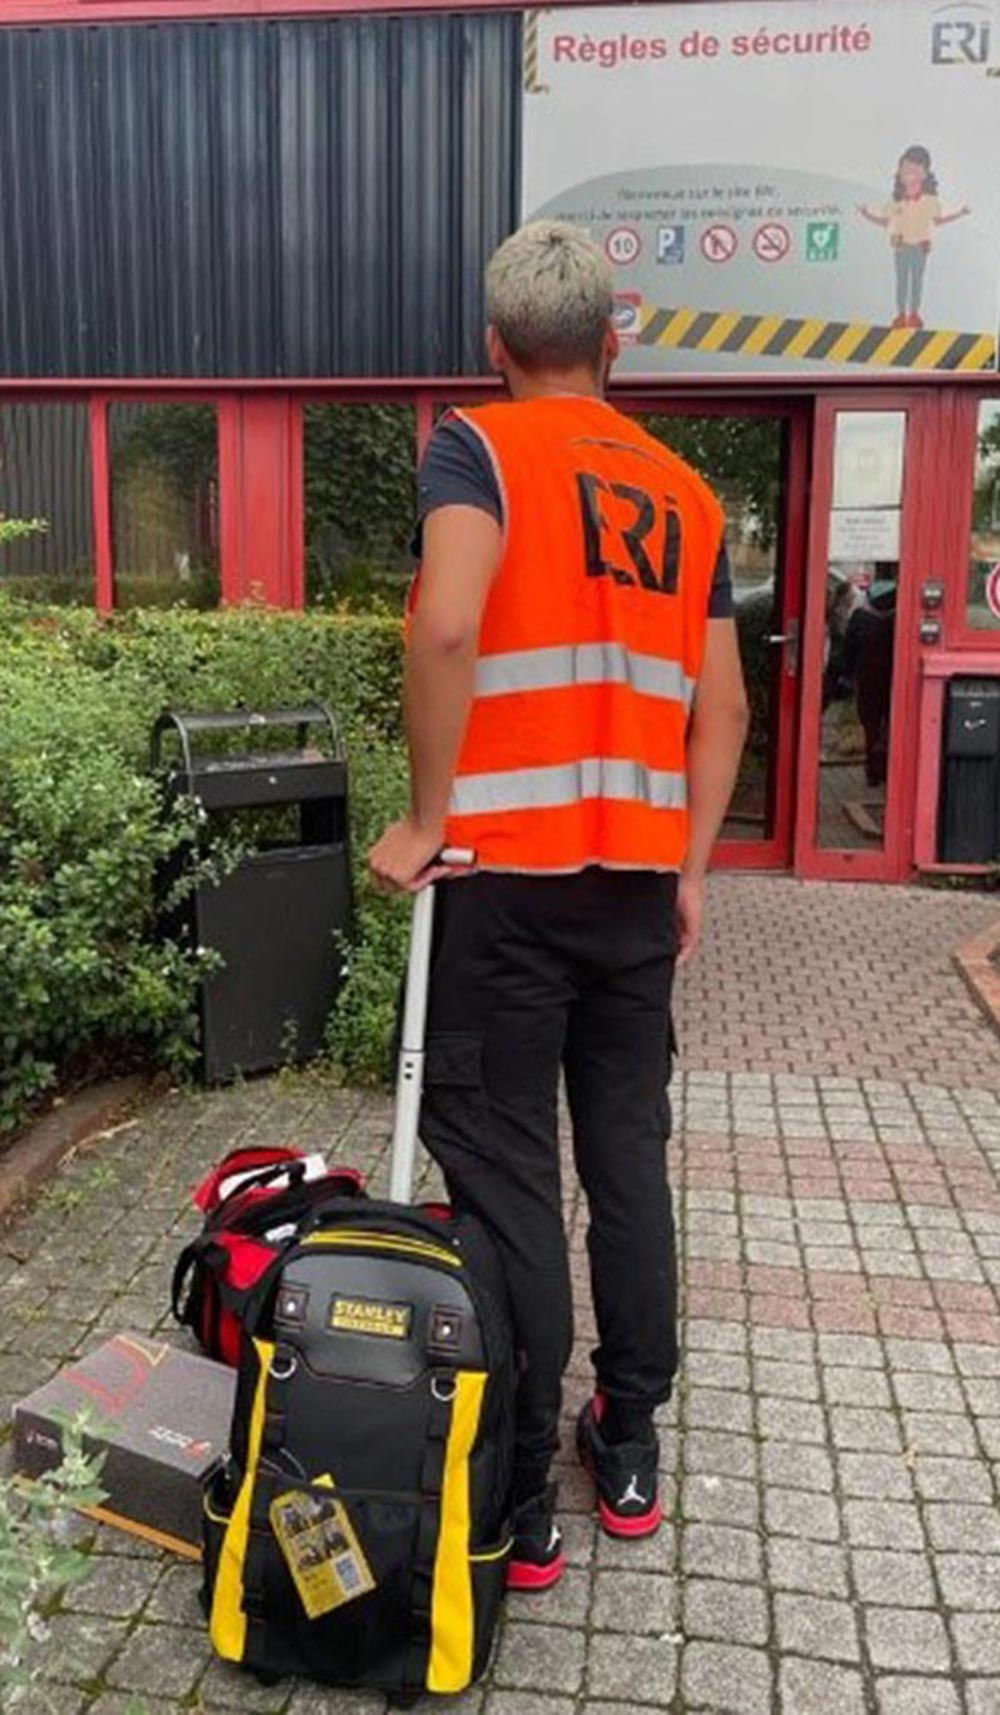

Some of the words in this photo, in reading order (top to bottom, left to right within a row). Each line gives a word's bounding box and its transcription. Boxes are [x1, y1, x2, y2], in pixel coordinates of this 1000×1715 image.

[554, 33, 667, 68] Règles
[680, 29, 720, 57] de
[731, 22, 871, 57] sécurité
[613, 237, 634, 255] 10
[658, 227, 676, 258] P
